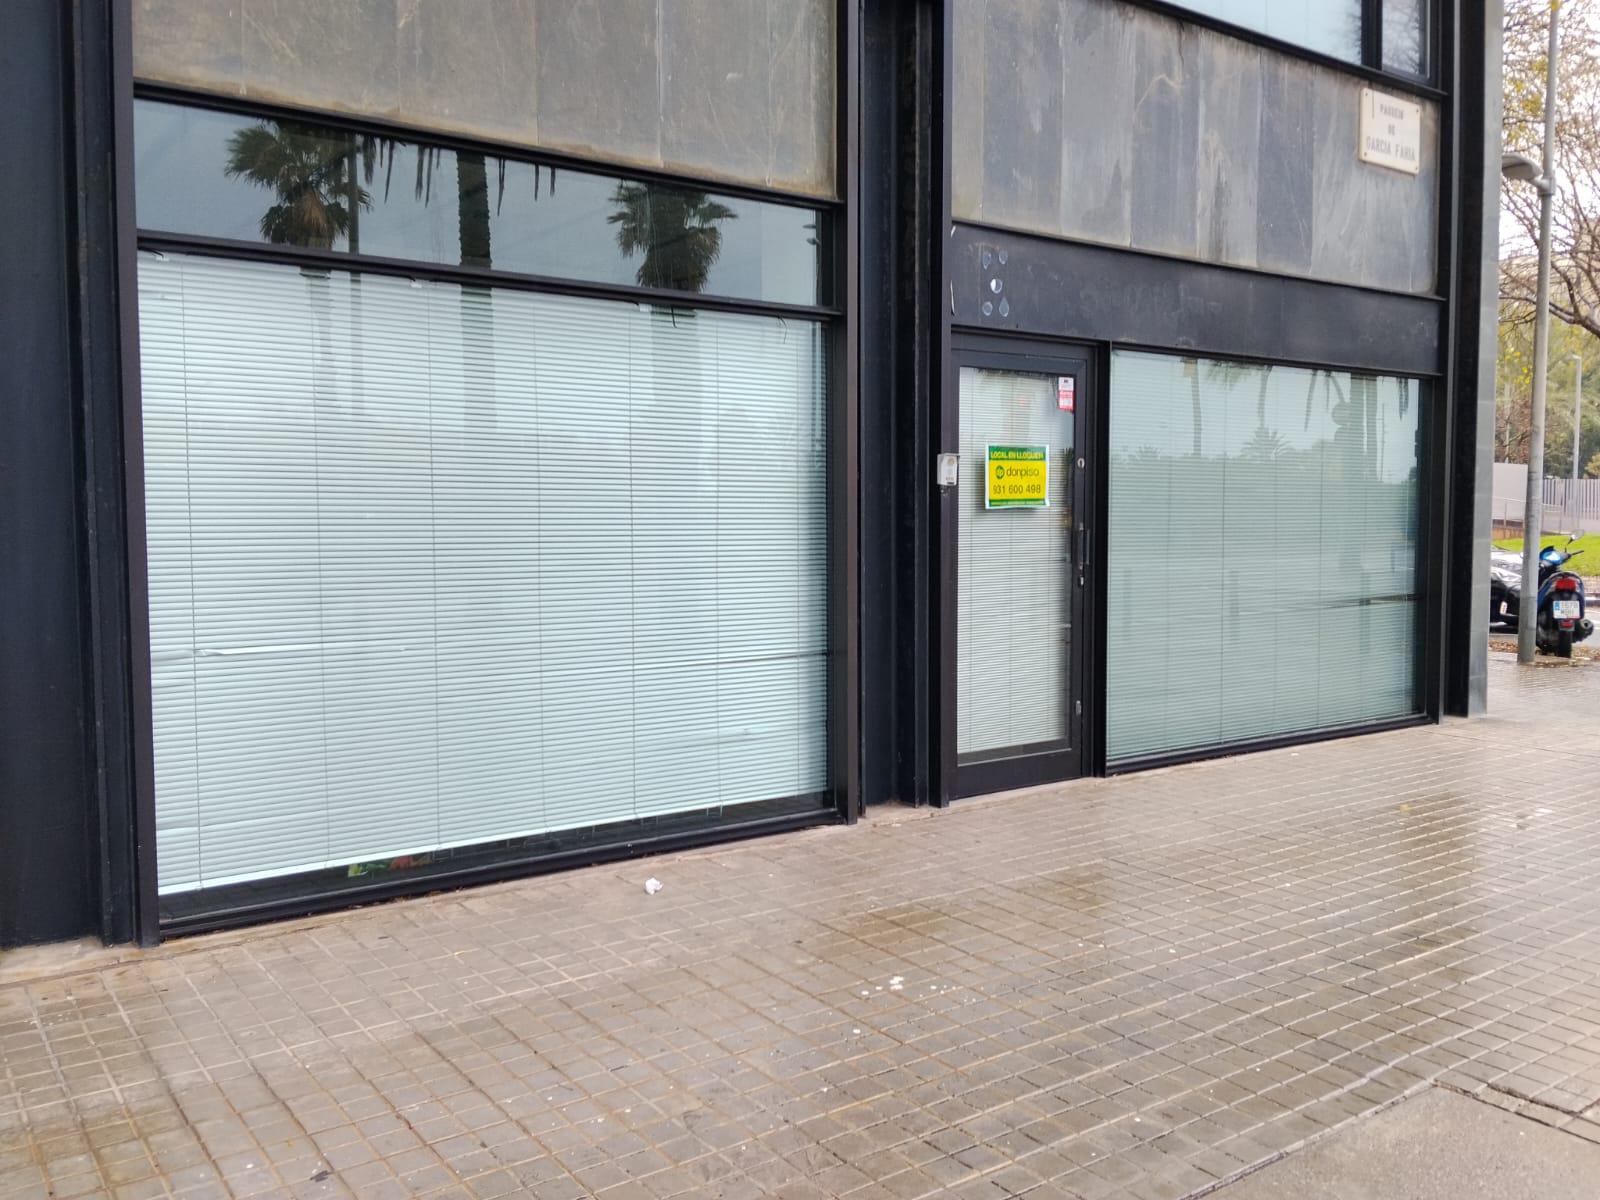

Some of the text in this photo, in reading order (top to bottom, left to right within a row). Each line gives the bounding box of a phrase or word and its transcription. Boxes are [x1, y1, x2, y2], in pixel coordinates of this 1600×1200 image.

[1006, 466, 1040, 480] donpiso
[993, 484, 1041, 495] 931 600 498
